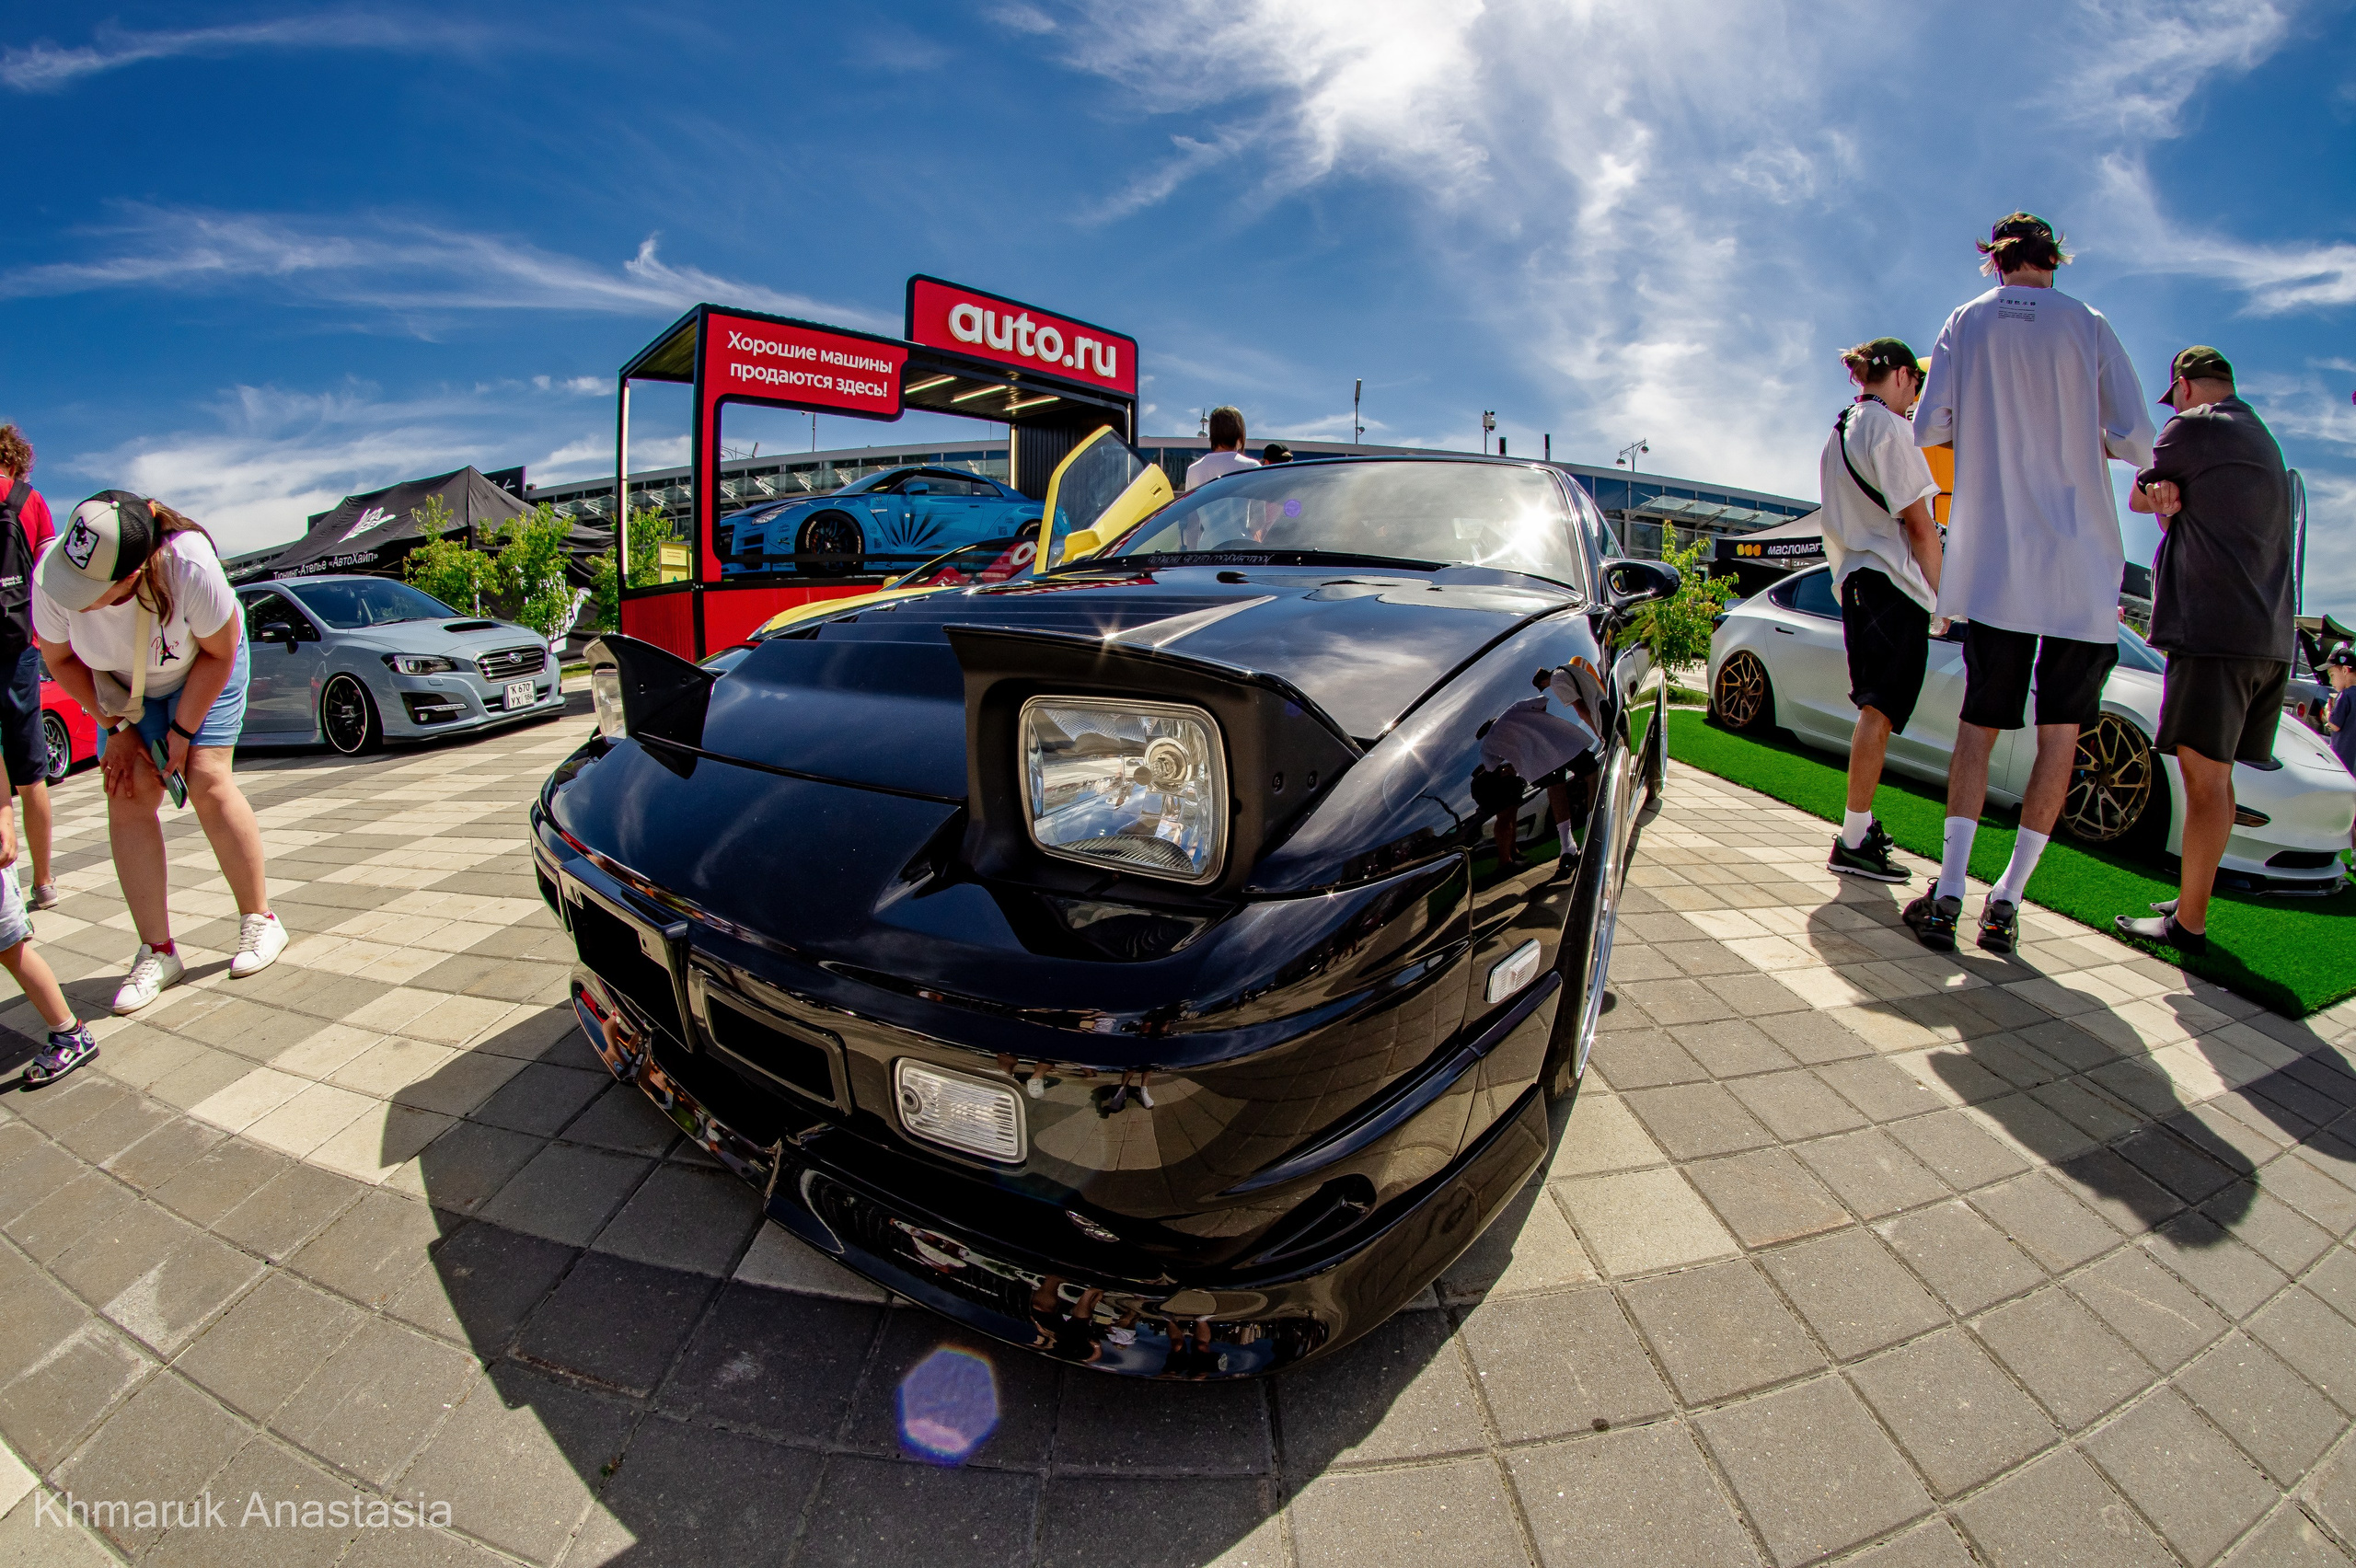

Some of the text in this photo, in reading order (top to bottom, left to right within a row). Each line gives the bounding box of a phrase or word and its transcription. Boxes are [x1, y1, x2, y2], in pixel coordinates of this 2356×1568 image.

[727, 330, 893, 374] Хорошие машины
[948, 303, 1116, 378] auto.ru
[730, 363, 888, 398] продаются здесь!
[273, 551, 378, 580] Тюнинг-Ателье «АвтоХайп»
